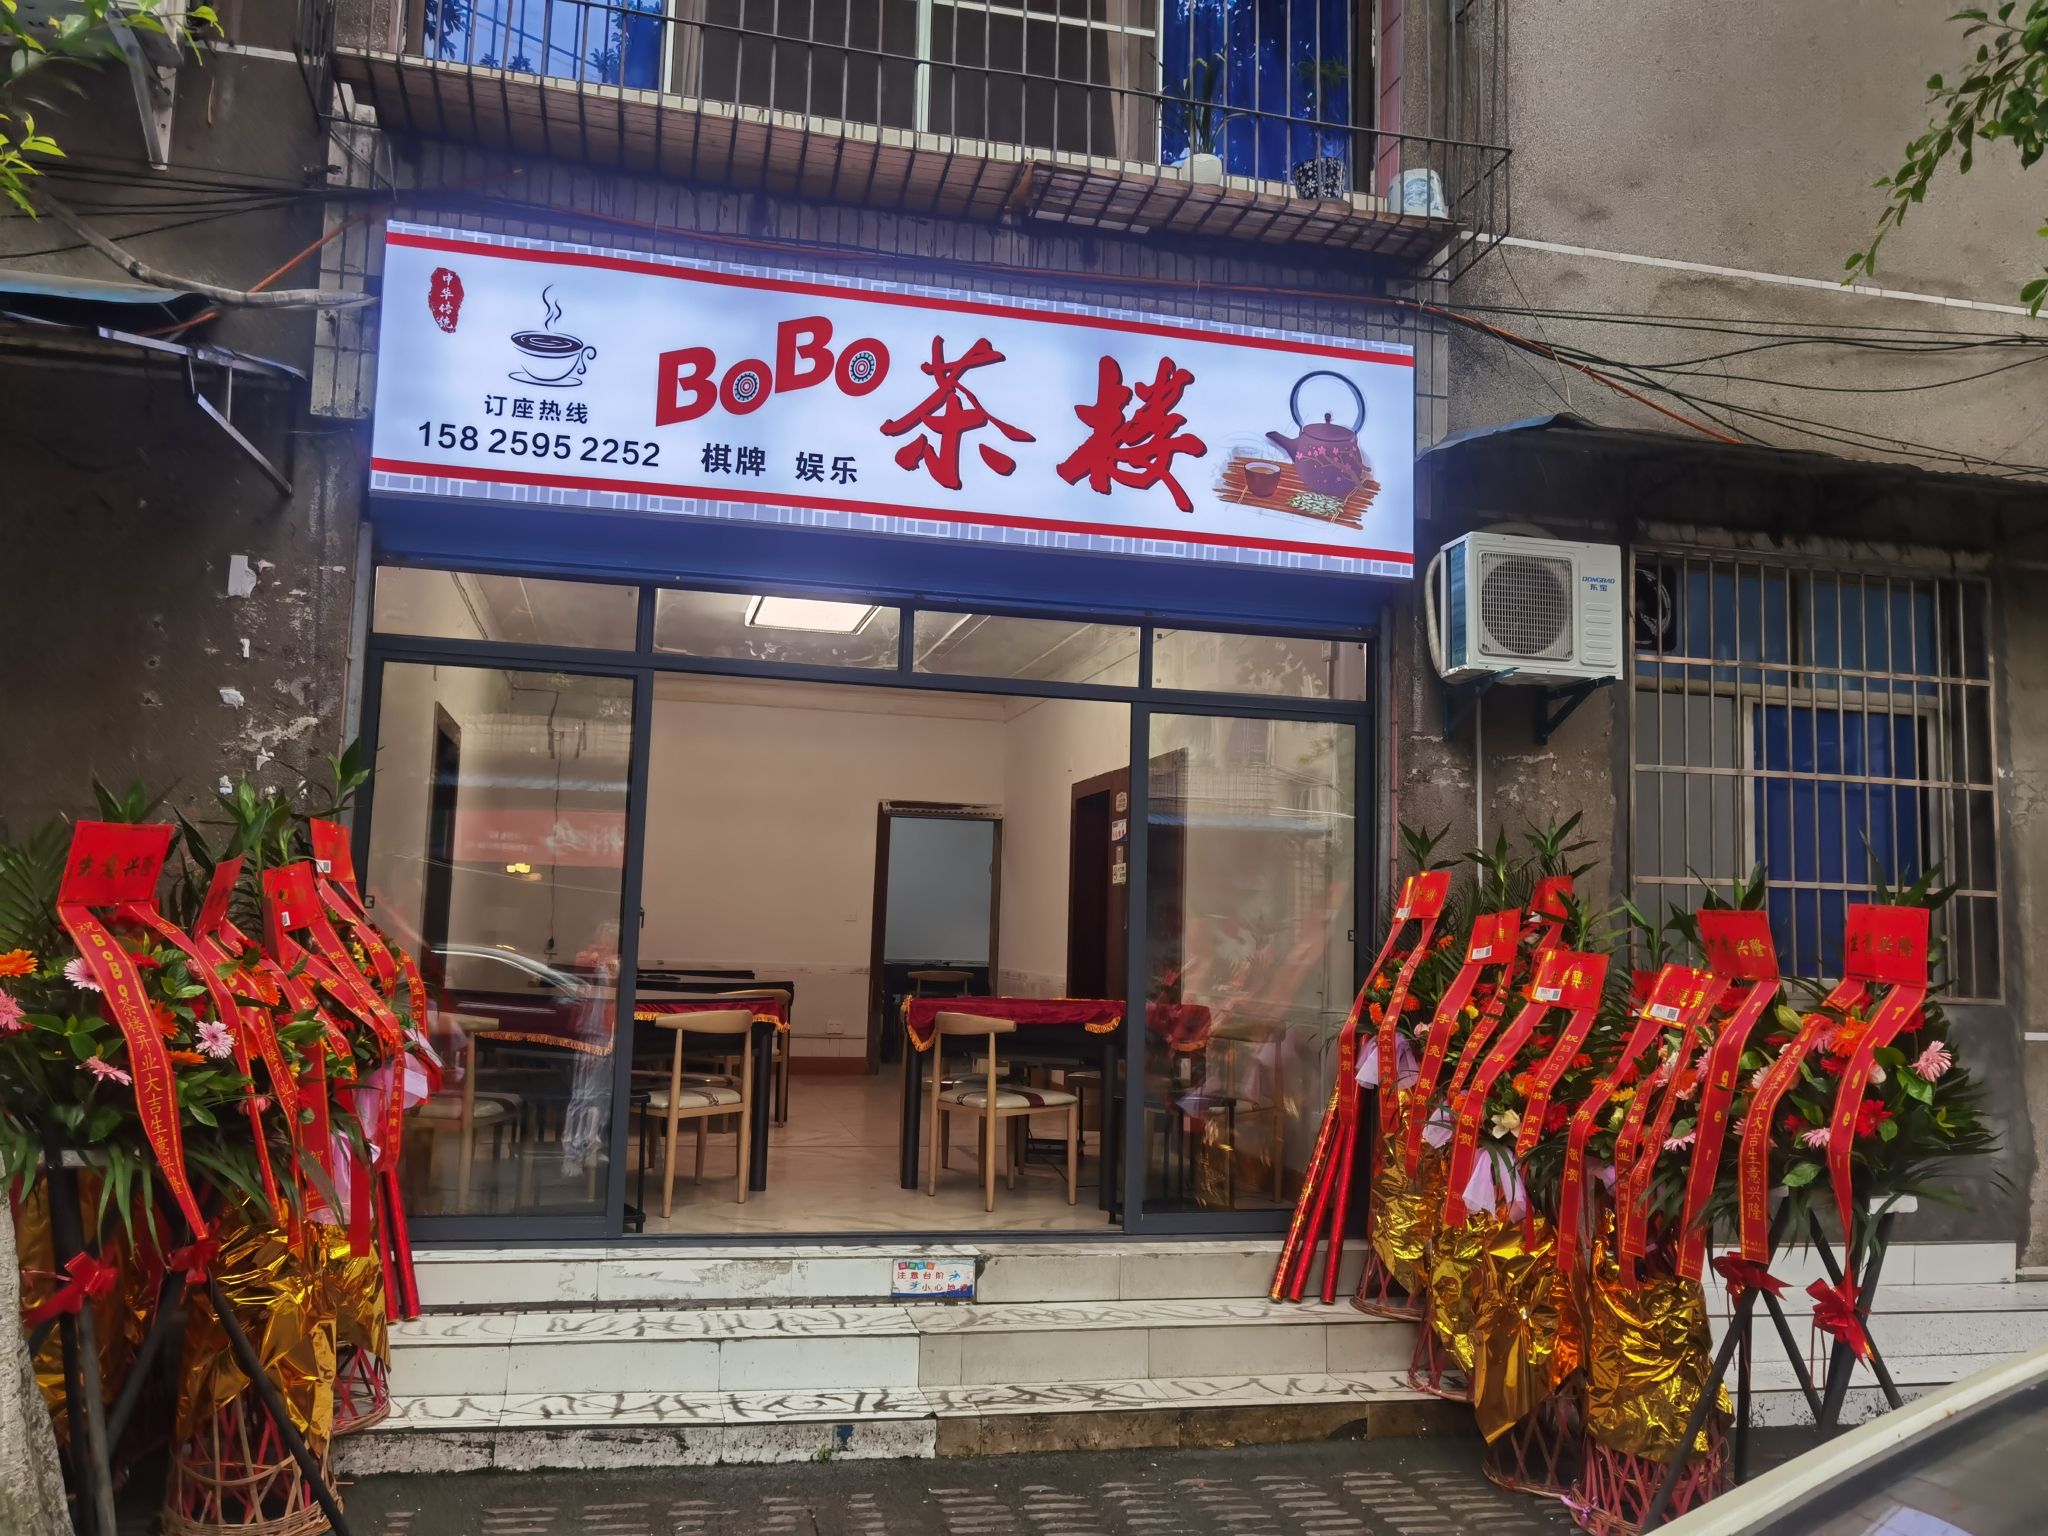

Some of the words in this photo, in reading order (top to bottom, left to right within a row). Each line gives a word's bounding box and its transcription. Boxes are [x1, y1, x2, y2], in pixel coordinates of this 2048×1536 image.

[436, 272, 454, 329] 中华传统
[483, 394, 589, 425] 订座热线
[880, 334, 1208, 513] 茶楼
[417, 421, 479, 451] 158
[488, 428, 571, 459] 2595
[580, 437, 661, 467] 2252
[701, 443, 768, 477] 棋牌
[795, 451, 859, 485] 娱乐
[897, 1271, 944, 1280] 注意台阶
